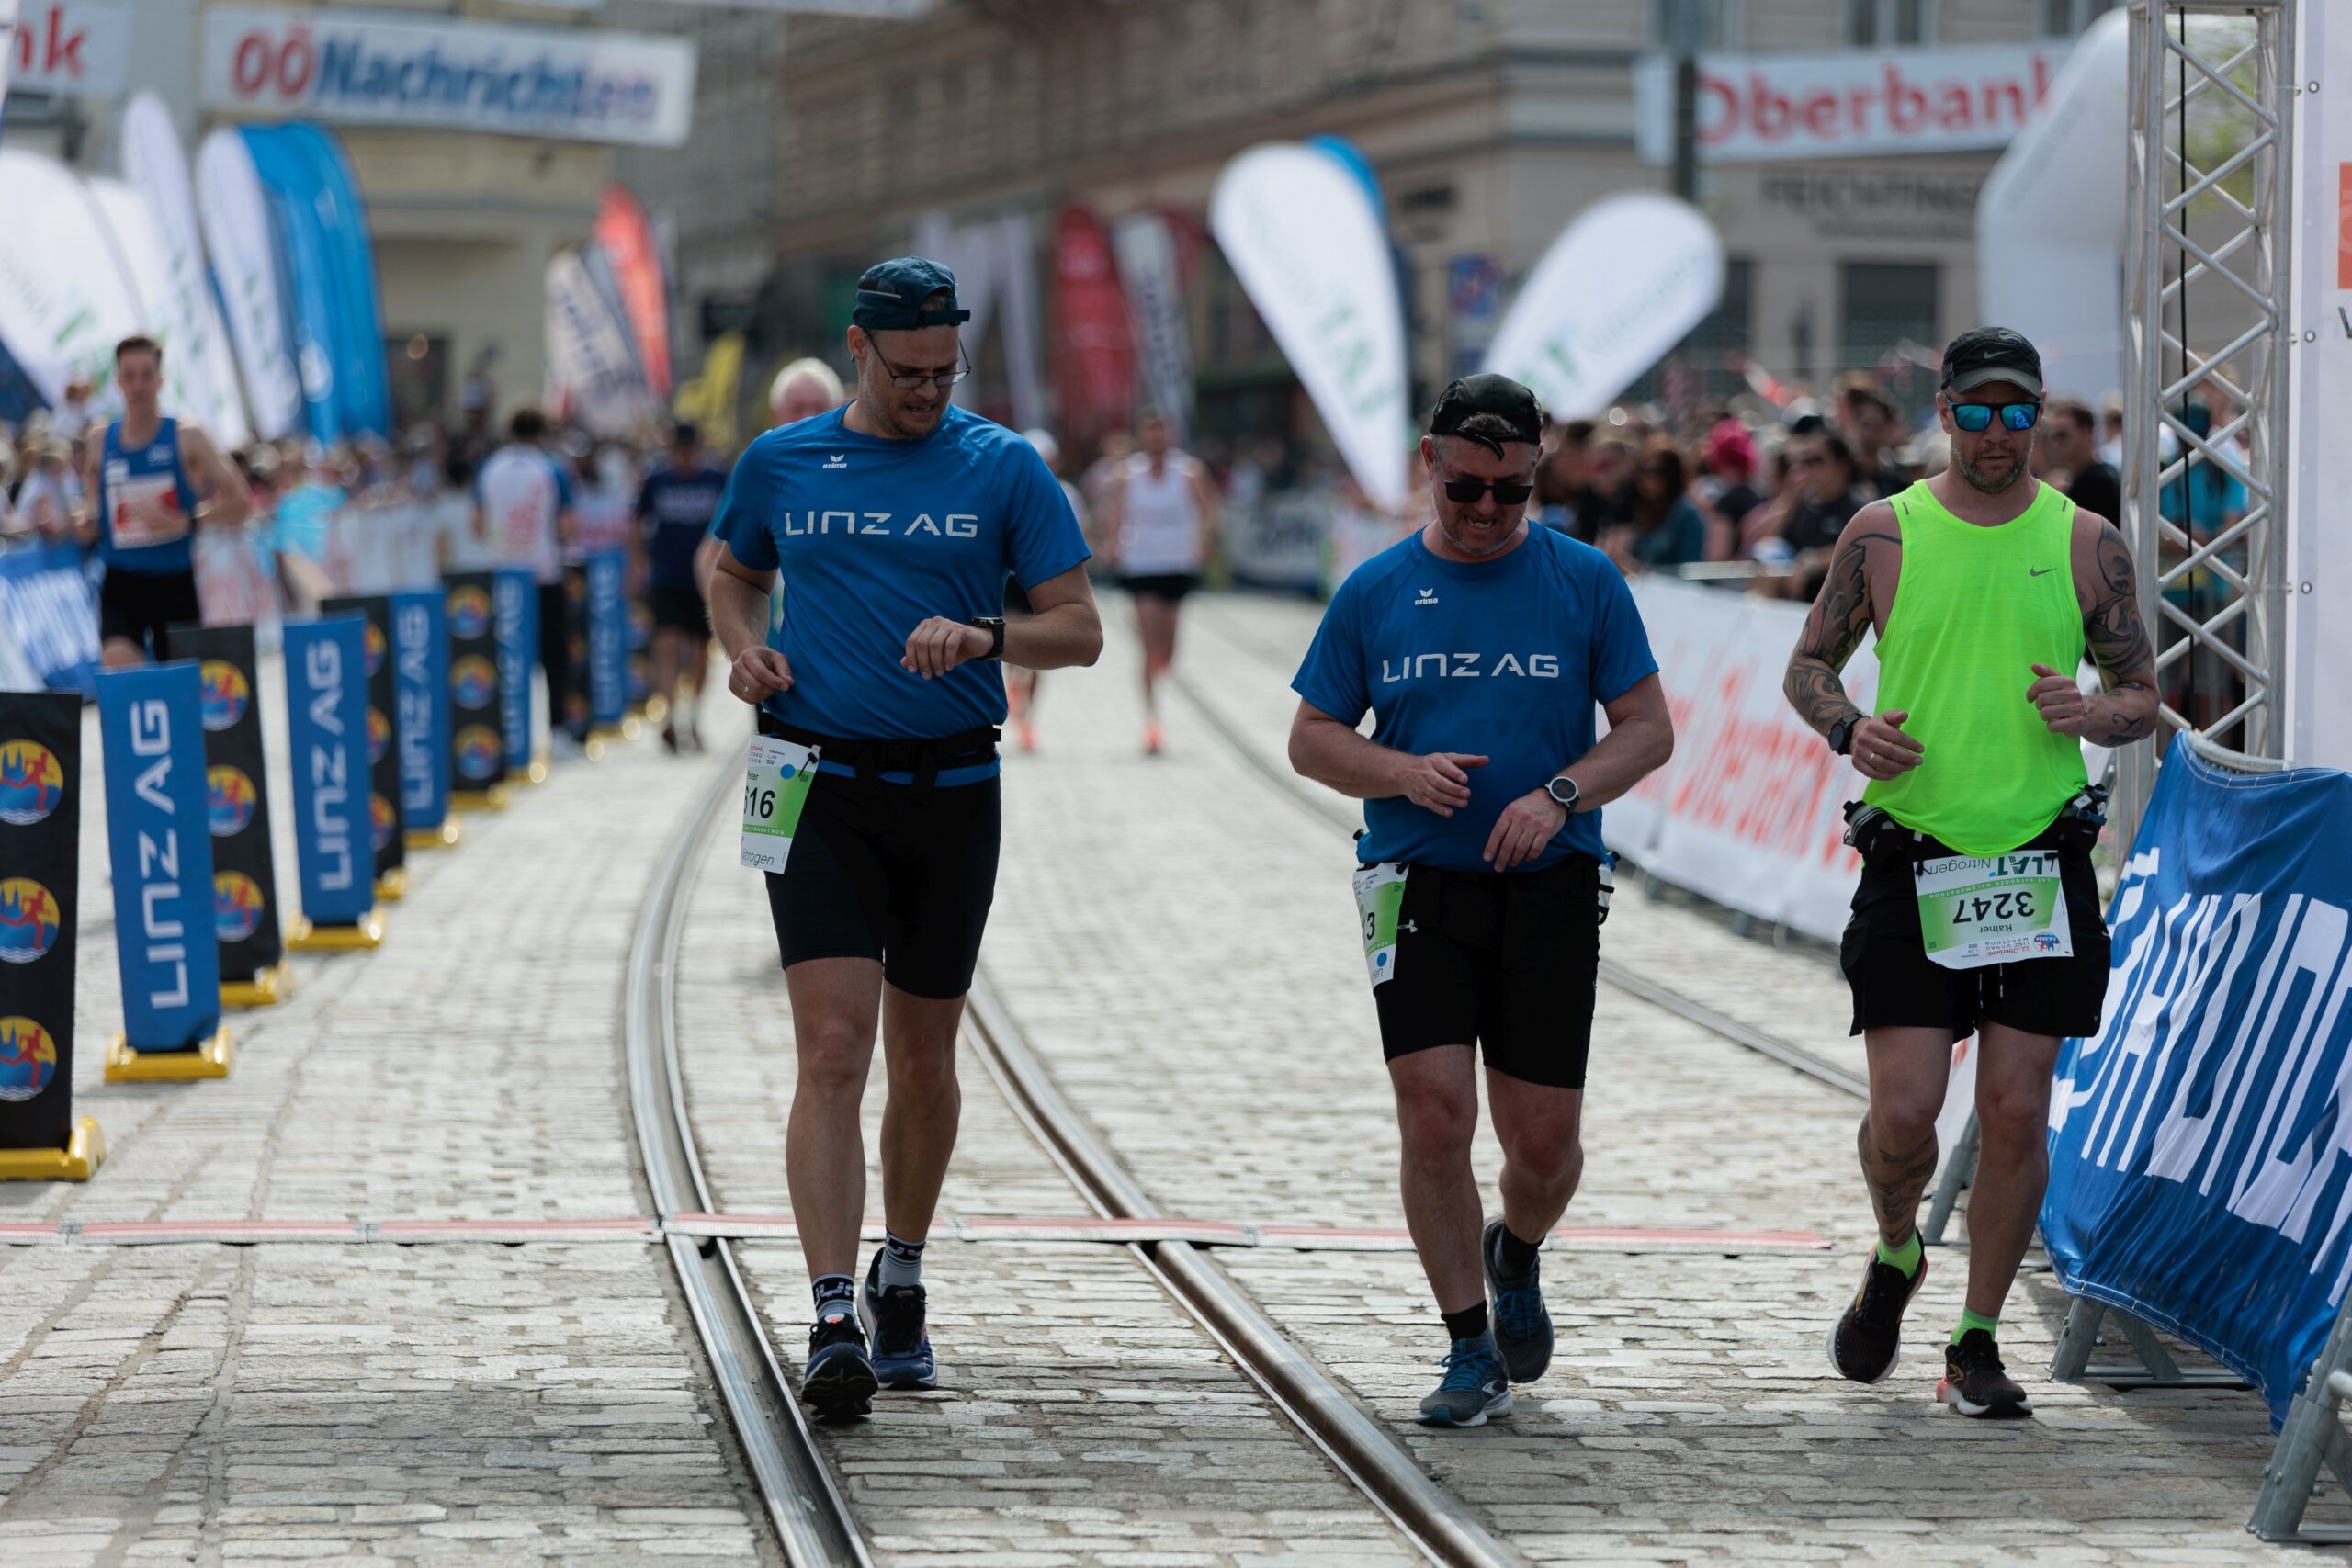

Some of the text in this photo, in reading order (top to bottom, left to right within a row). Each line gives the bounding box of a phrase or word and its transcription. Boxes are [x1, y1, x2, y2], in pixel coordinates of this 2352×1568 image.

[785, 510, 978, 538] LINZ AG
[1414, 597, 1439, 606] erima
[1383, 653, 1559, 683] LINZ AG
[306, 639, 345, 736] AG
[130, 699, 175, 815] AG
[1929, 855, 2043, 877] LAT Nitrogen
[1952, 891, 2035, 924] 3247
[1979, 923, 2012, 934] Rainer
